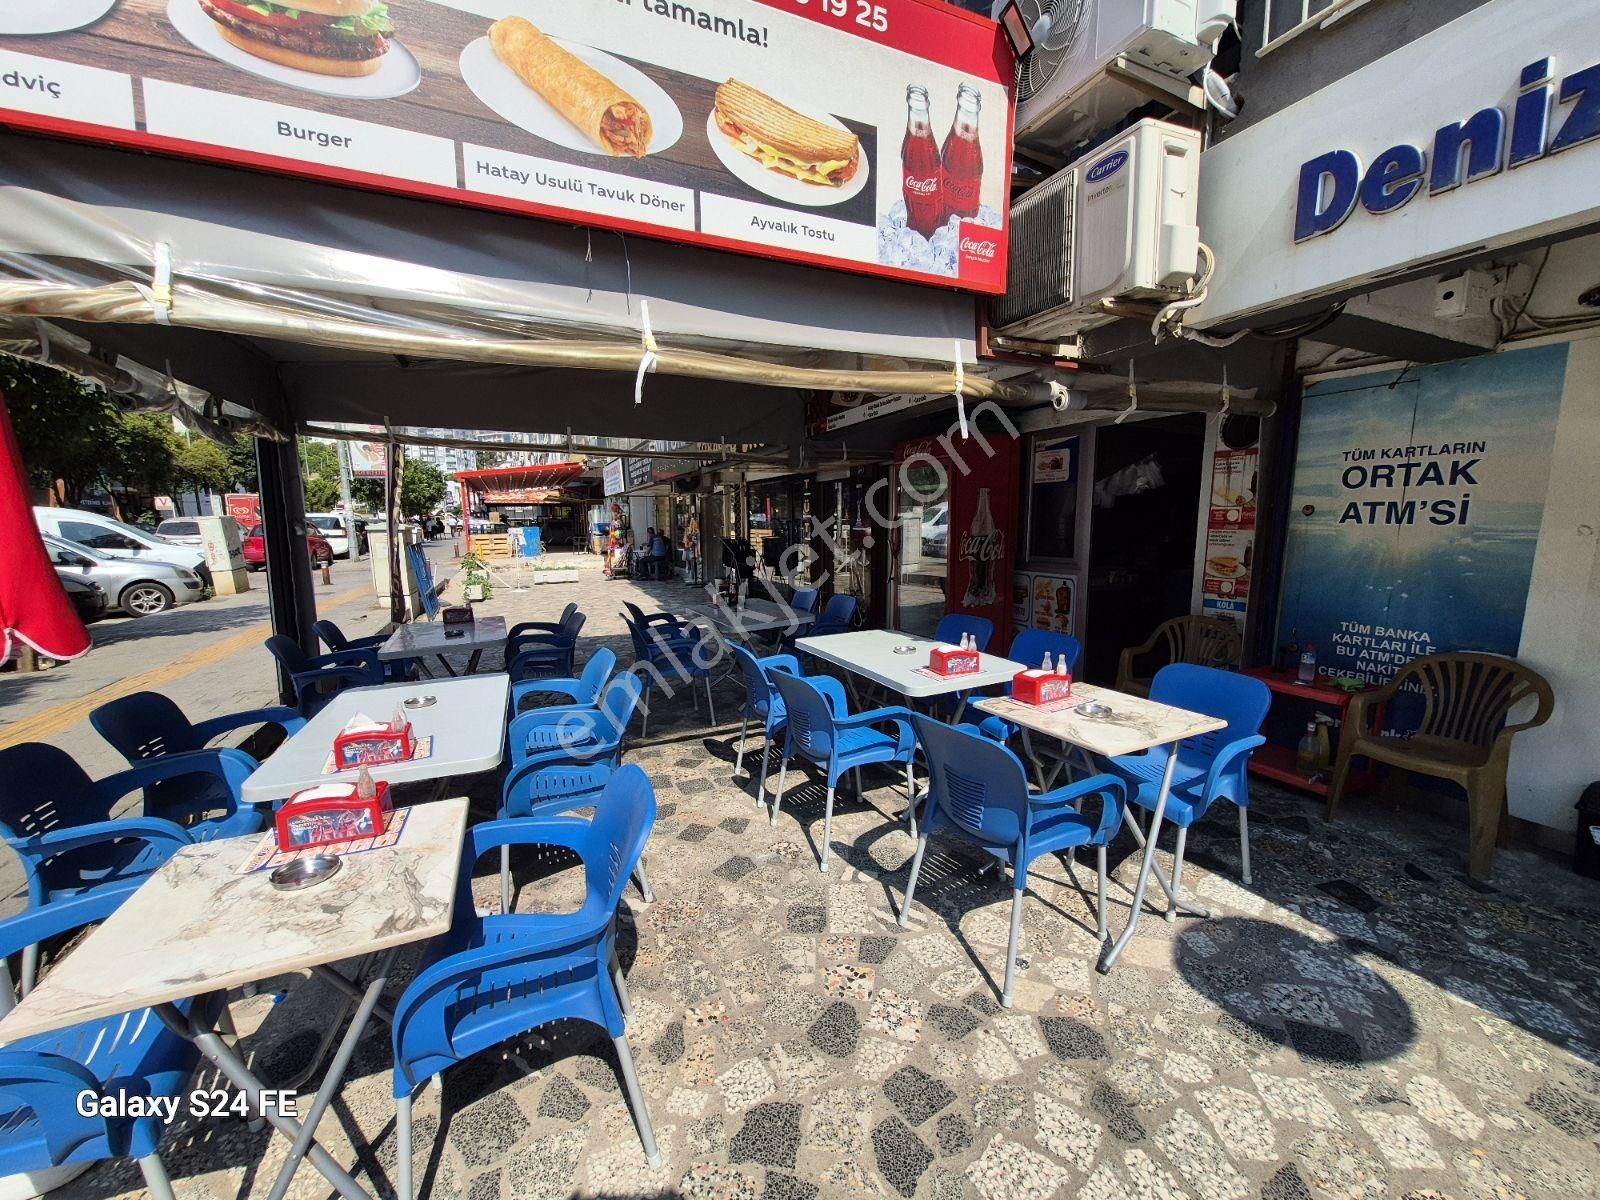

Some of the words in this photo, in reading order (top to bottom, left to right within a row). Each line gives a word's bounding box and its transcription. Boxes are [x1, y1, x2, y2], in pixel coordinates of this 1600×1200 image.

[856, 0, 888, 32] 25
[276, 121, 353, 149] Burger
[1091, 156, 1123, 178] Carrier
[476, 160, 530, 185] Hatay
[535, 173, 583, 193] Usulü
[588, 182, 636, 203] Tavuk
[640, 193, 686, 214] Döner
[750, 216, 798, 237] Ayvalık
[801, 226, 835, 242] Tostu
[1342, 448, 1376, 462] TÜM
[1380, 441, 1487, 460] KARTLARIN
[1341, 459, 1483, 490] ORTAK
[1340, 621, 1370, 635] TÜM
[1374, 626, 1431, 643] BANKA
[1332, 633, 1406, 653] KARTLARI
[1410, 641, 1437, 656] İLE
[1336, 645, 1356, 657] BU
[1356, 660, 1402, 675] NAKİT
